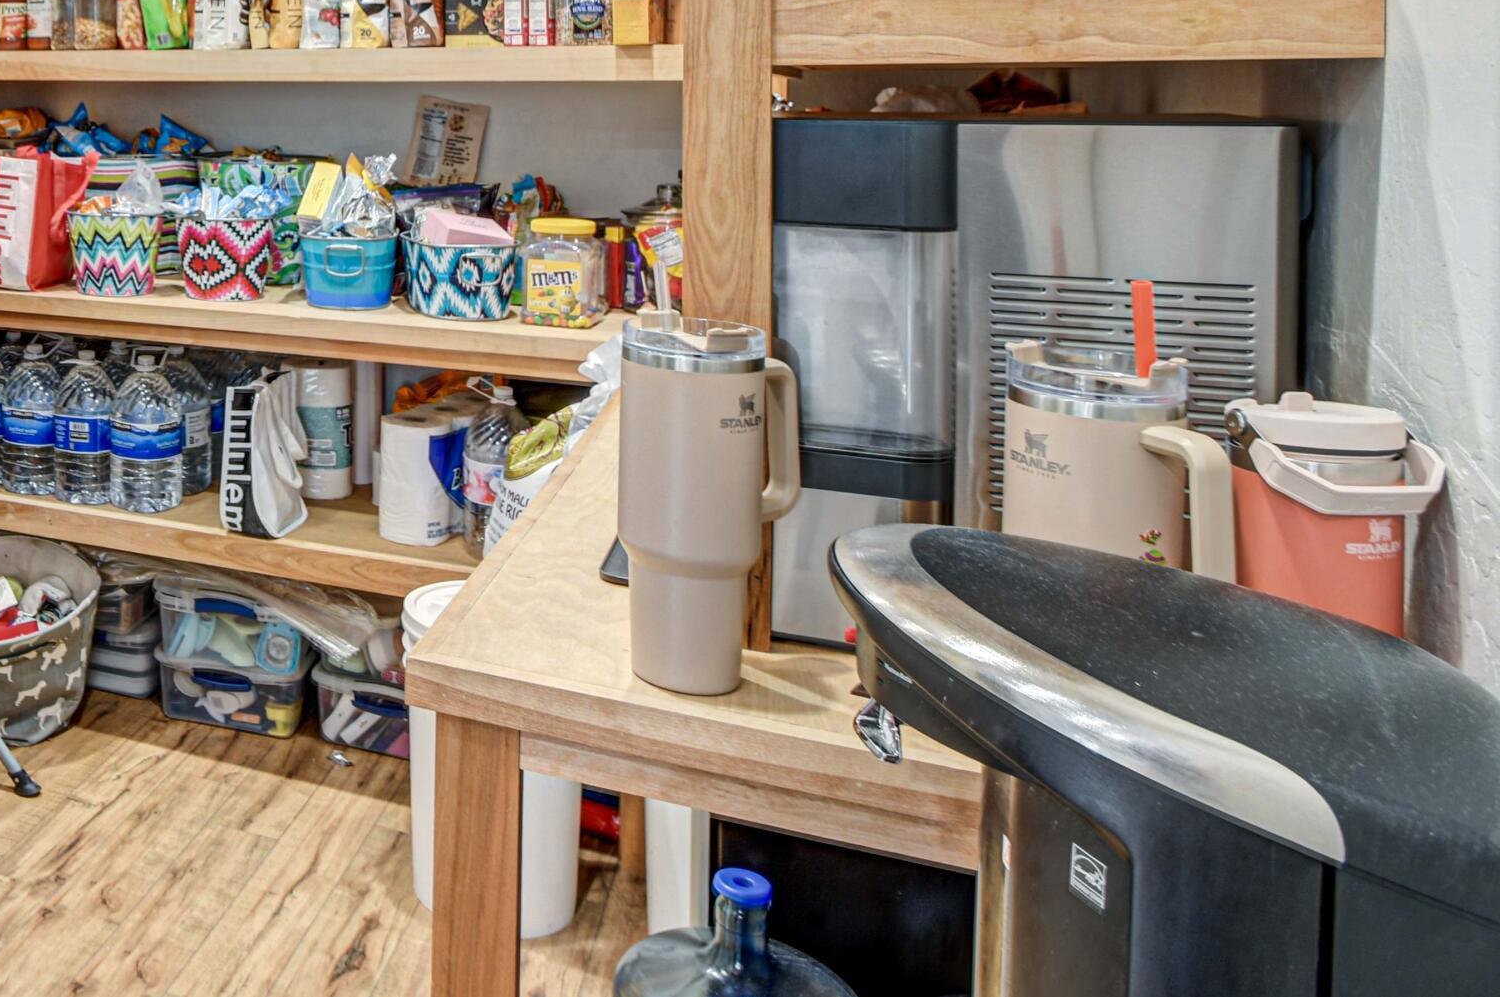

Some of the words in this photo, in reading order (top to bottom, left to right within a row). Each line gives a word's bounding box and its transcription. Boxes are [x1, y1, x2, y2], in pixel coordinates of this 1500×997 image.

[361, 29, 372, 37] 20
[413, 26, 425, 35] 20
[1009, 452, 1068, 476] STANLEY
[505, 504, 523, 520] RIC
